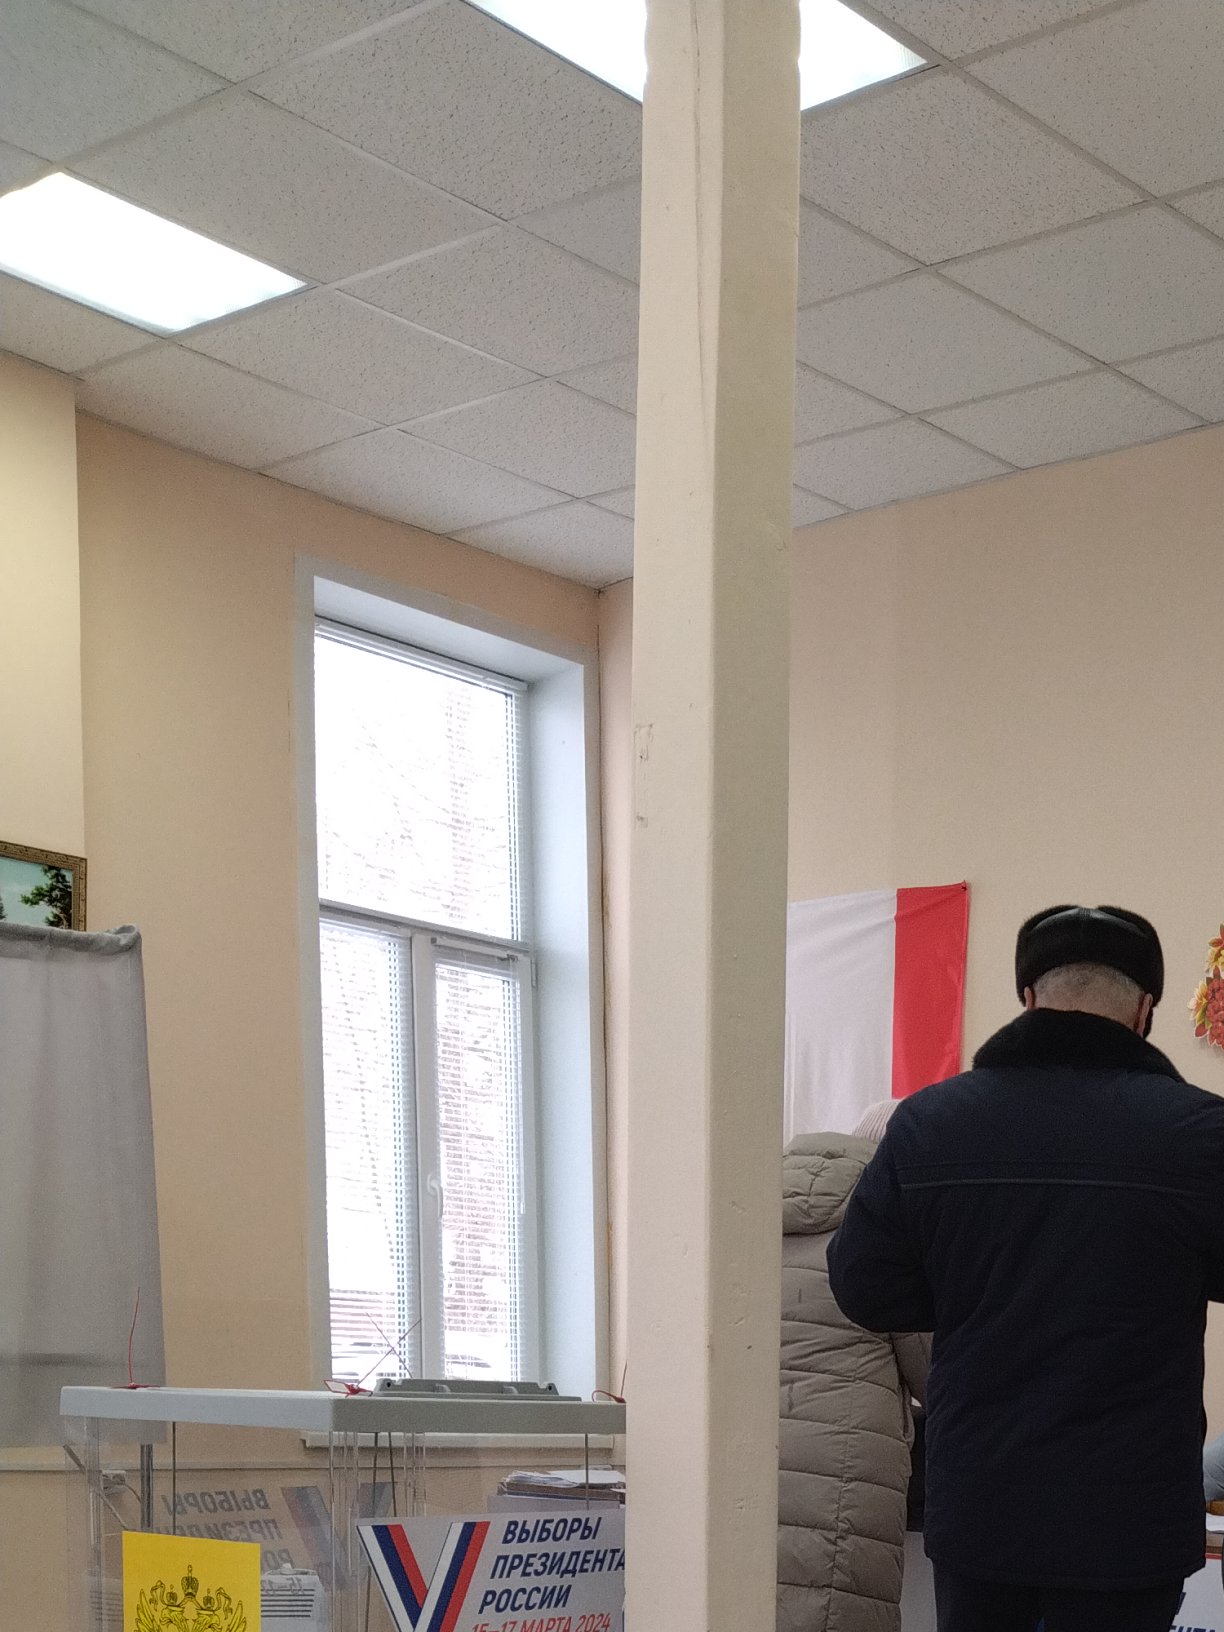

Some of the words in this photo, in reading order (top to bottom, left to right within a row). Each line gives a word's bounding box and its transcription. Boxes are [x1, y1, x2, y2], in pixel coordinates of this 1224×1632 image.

[502, 1517, 602, 1544] ВЫБОРЫ
[490, 1548, 625, 1579] ПРЕЗИДЕНТА
[478, 1585, 572, 1614] РОССИИ
